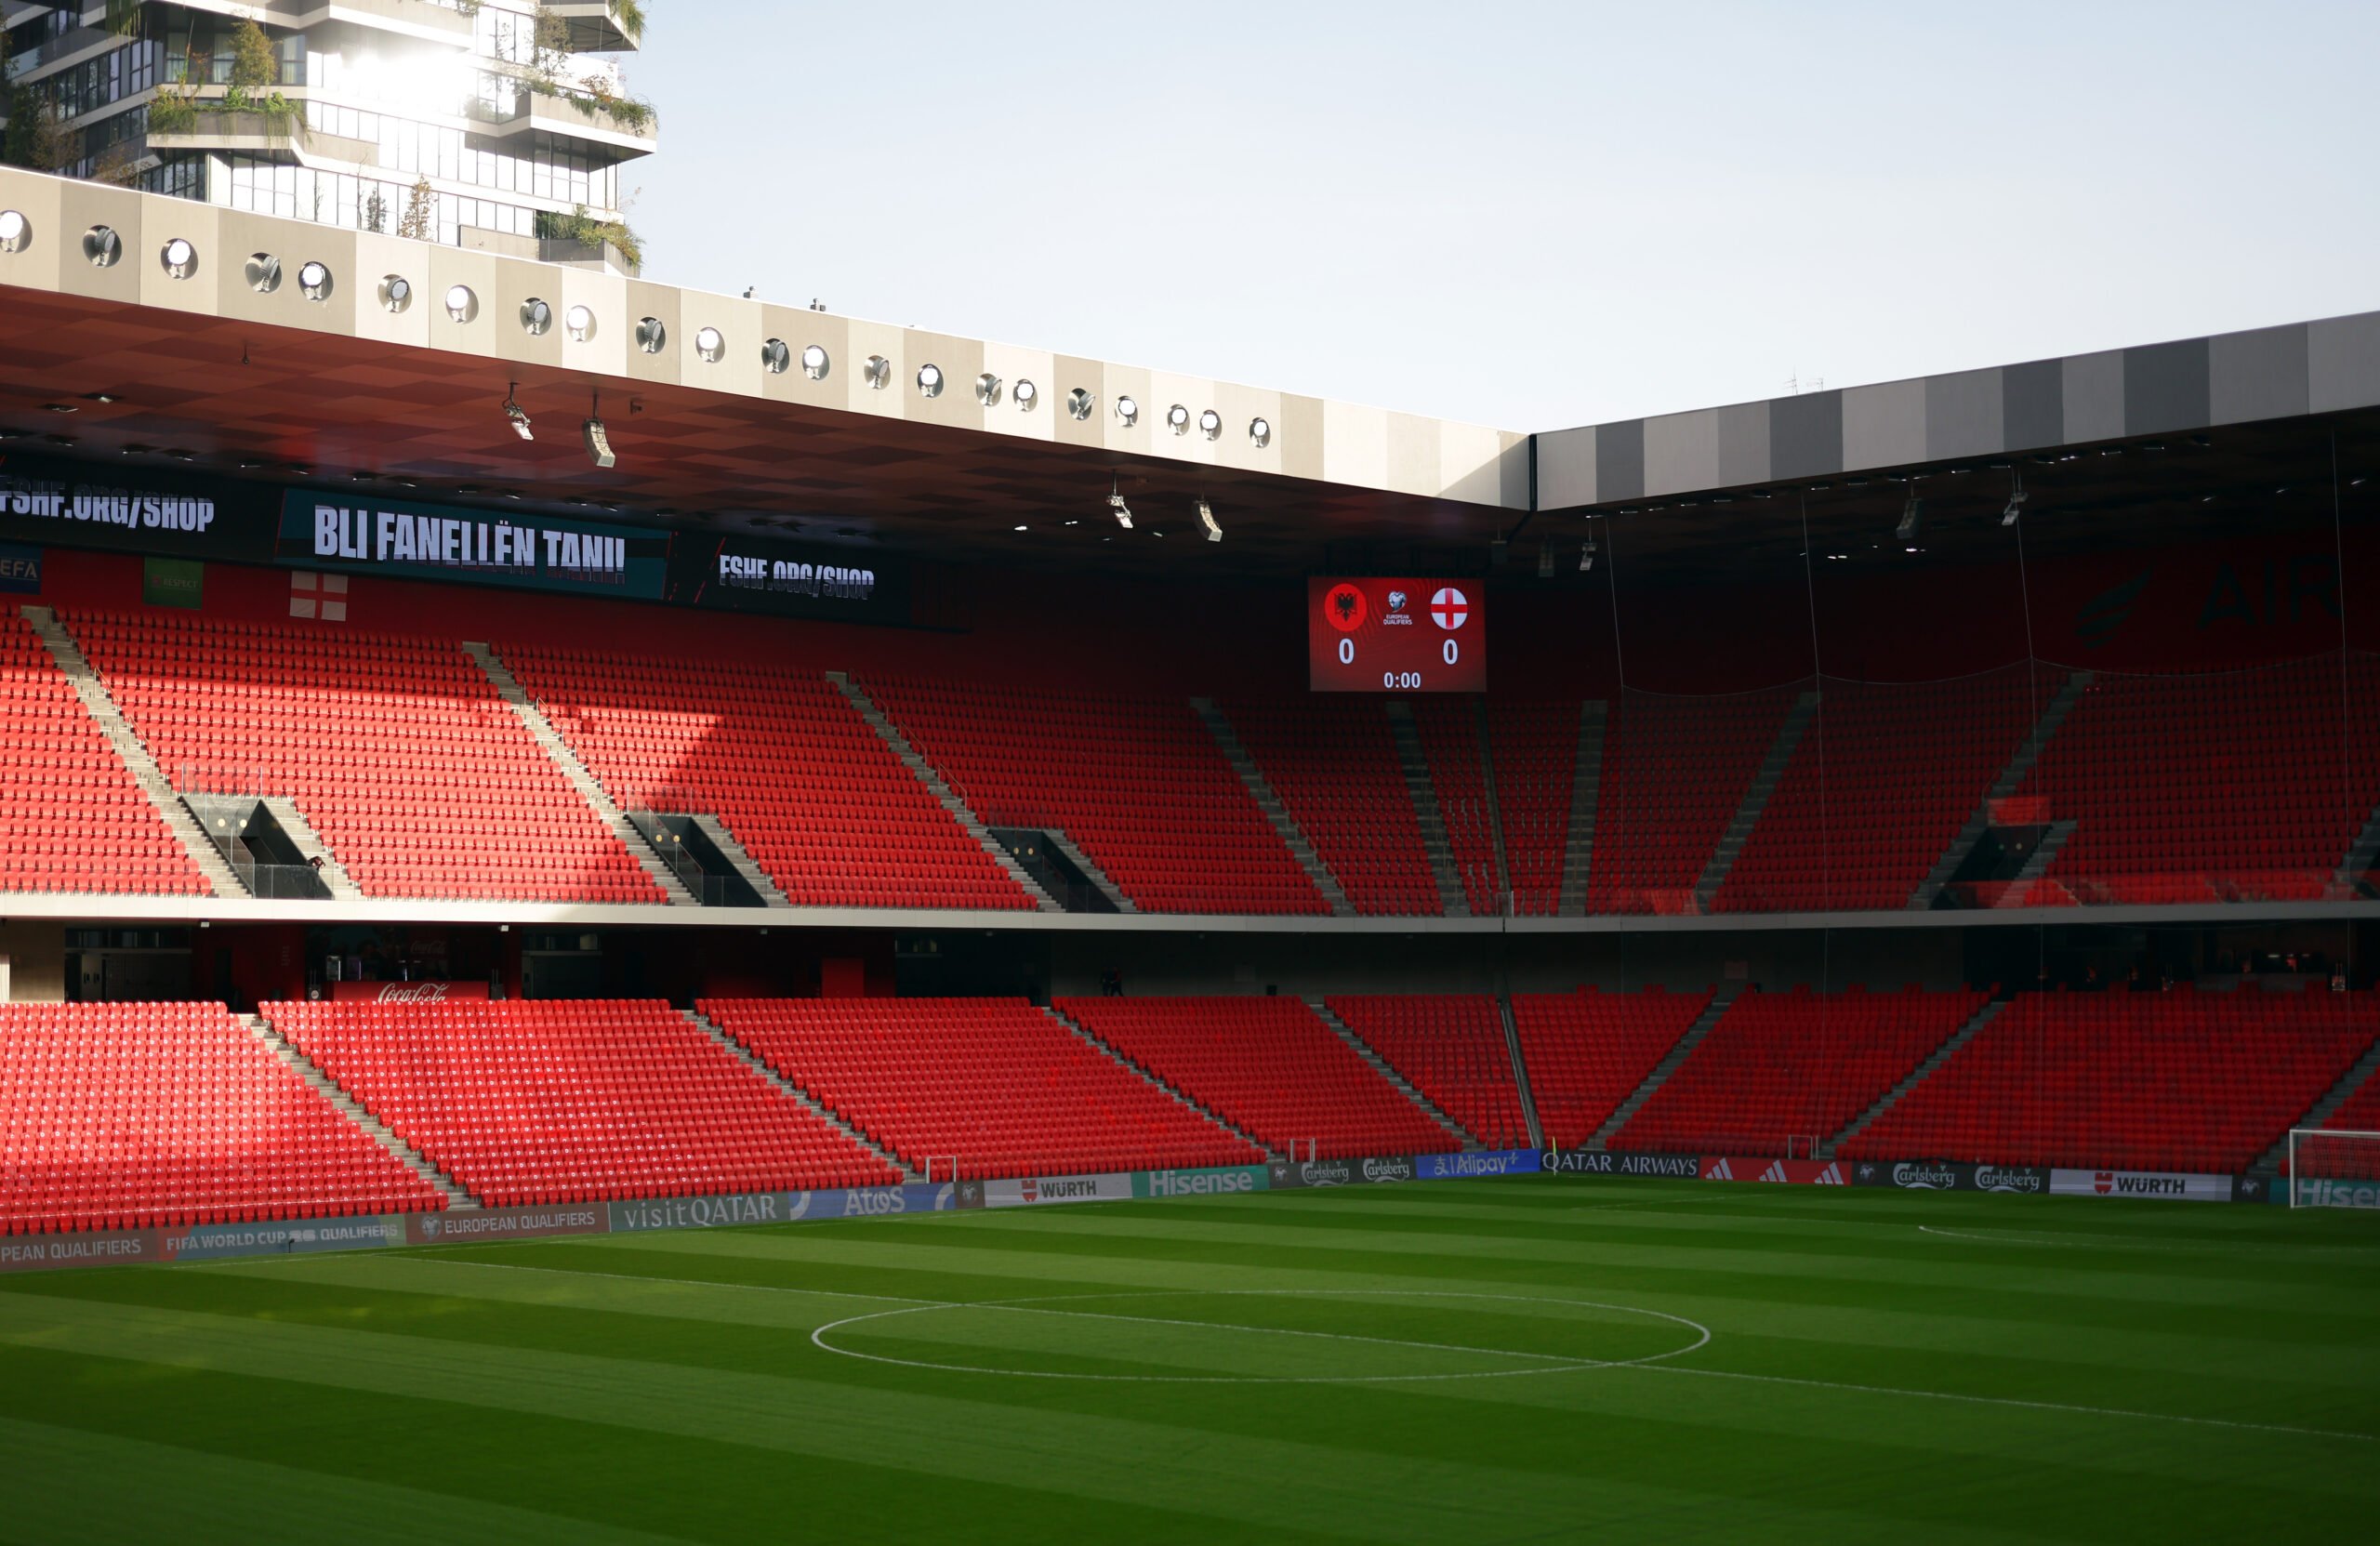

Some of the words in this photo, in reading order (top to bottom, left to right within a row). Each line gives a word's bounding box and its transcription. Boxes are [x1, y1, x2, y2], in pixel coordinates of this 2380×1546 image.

[314, 505, 368, 560] BLI
[719, 554, 875, 601] FSHF.ORG/SHOP
[2196, 556, 2343, 628] AIR
[1339, 639, 1355, 665] 0
[1443, 639, 1459, 666] 0
[1383, 672, 1421, 689] 0:00
[1302, 1161, 1350, 1185] Carlsberg
[1363, 1158, 1410, 1183] Carlsberg
[1542, 1152, 1612, 1173] QATAR
[1620, 1156, 1698, 1176] AIRWAYS
[1893, 1163, 1955, 1189] Carlsberg
[1149, 1171, 1253, 1197] Hisense
[1975, 1166, 2041, 1192] Carlsberg
[2117, 1177, 2186, 1195] WÜRTH
[2297, 1177, 2380, 1206] Hise
[444, 1217, 517, 1235] EUROPEAN
[521, 1211, 596, 1230] QUALIFIERS
[50, 1238, 142, 1260] QUALIFIERS
[166, 1236, 199, 1251] FIFA
[198, 1234, 255, 1249] WORLD
[258, 1231, 286, 1246] CUP
[320, 1224, 399, 1241] QUALIFIERS
